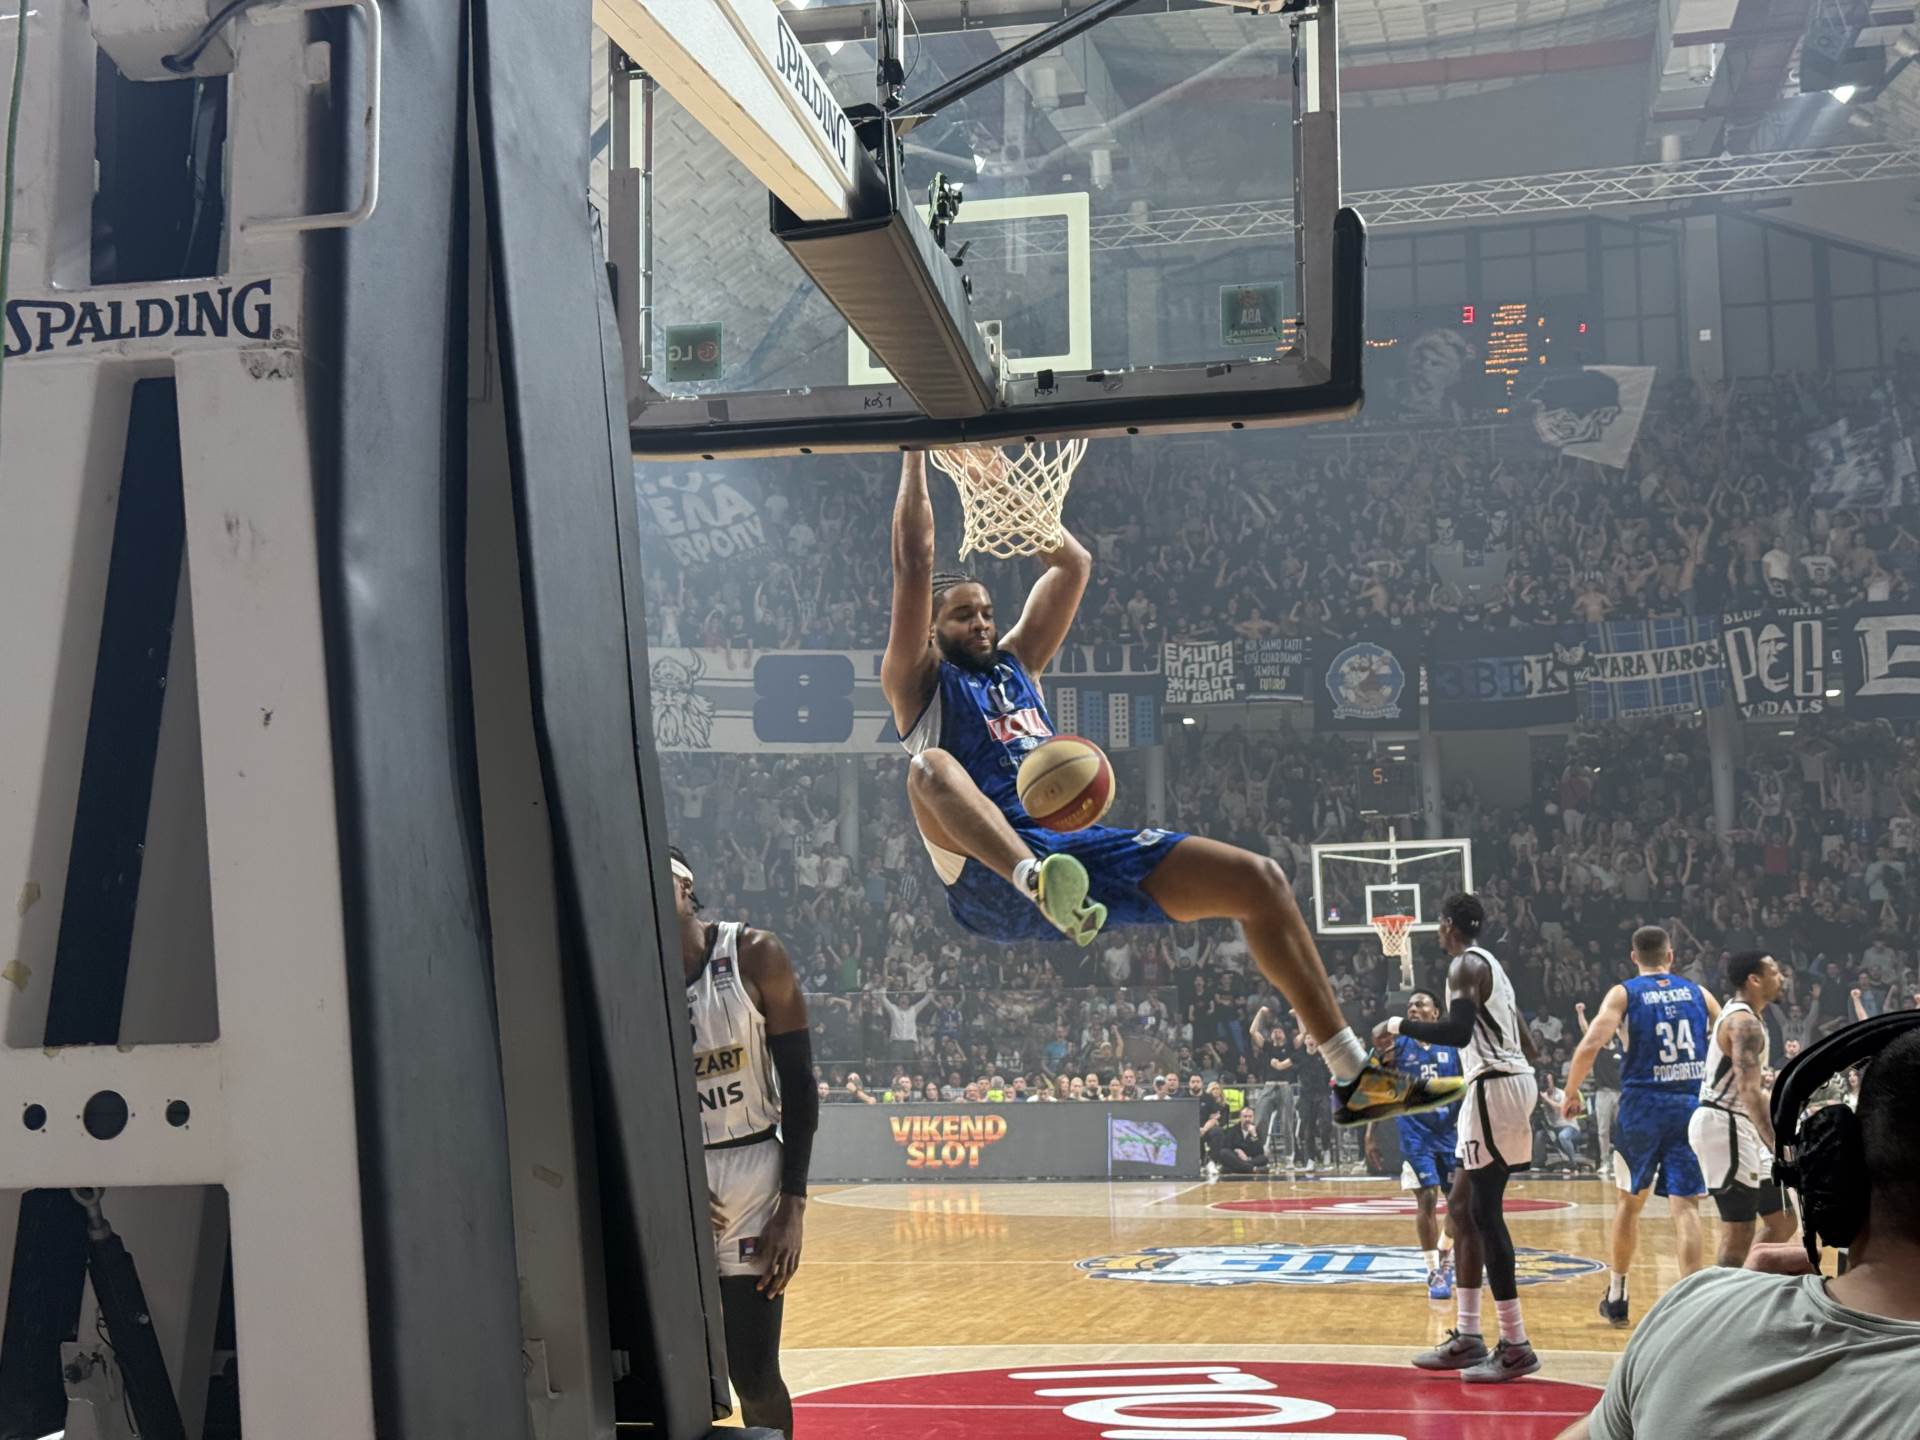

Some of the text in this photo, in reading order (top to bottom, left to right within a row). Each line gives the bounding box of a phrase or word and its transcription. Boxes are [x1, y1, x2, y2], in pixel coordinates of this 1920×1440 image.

[777, 14, 846, 168] SPALDING
[4, 279, 271, 357] SPALDING
[1588, 654, 1648, 678] STARA
[1655, 1019, 1696, 1064] 34
[890, 1114, 1008, 1143] VIKEND
[905, 1140, 985, 1169] SLOT
[1464, 1140, 1480, 1166] 17
